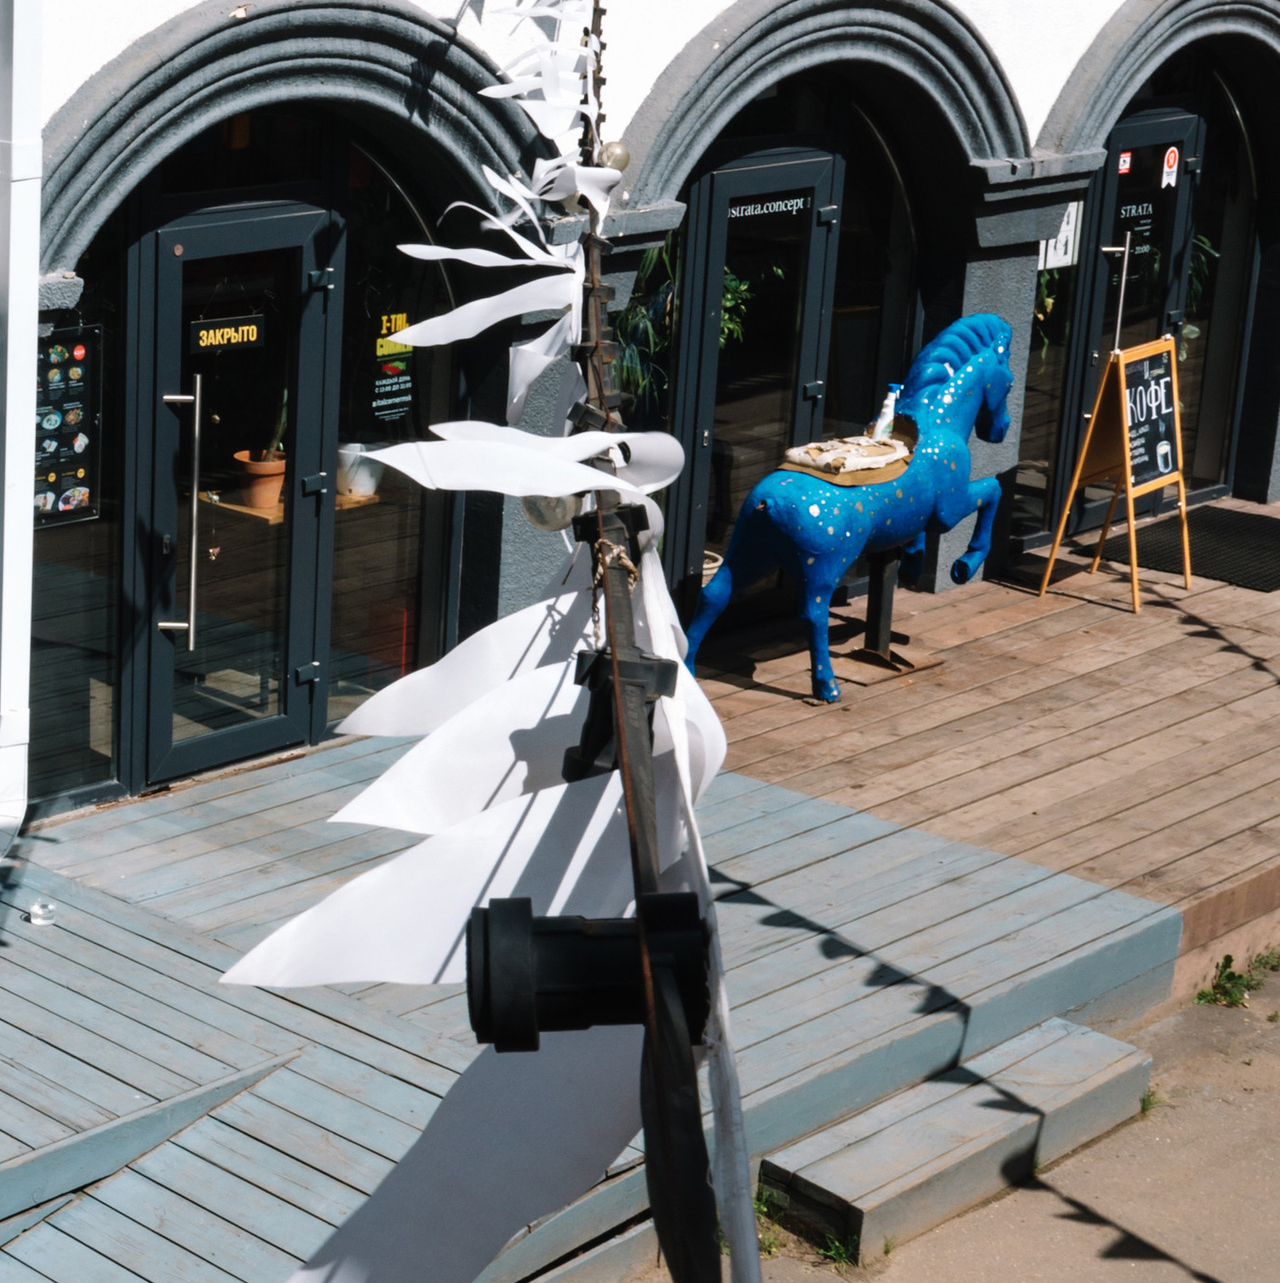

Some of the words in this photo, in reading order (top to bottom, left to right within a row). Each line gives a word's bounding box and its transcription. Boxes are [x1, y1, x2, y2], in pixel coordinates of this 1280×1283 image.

[728, 198, 804, 218] strata.concept
[1120, 203, 1153, 219] STRATA
[199, 324, 257, 347] ЗАКРЫТО
[1125, 376, 1173, 427] КОФЕ
